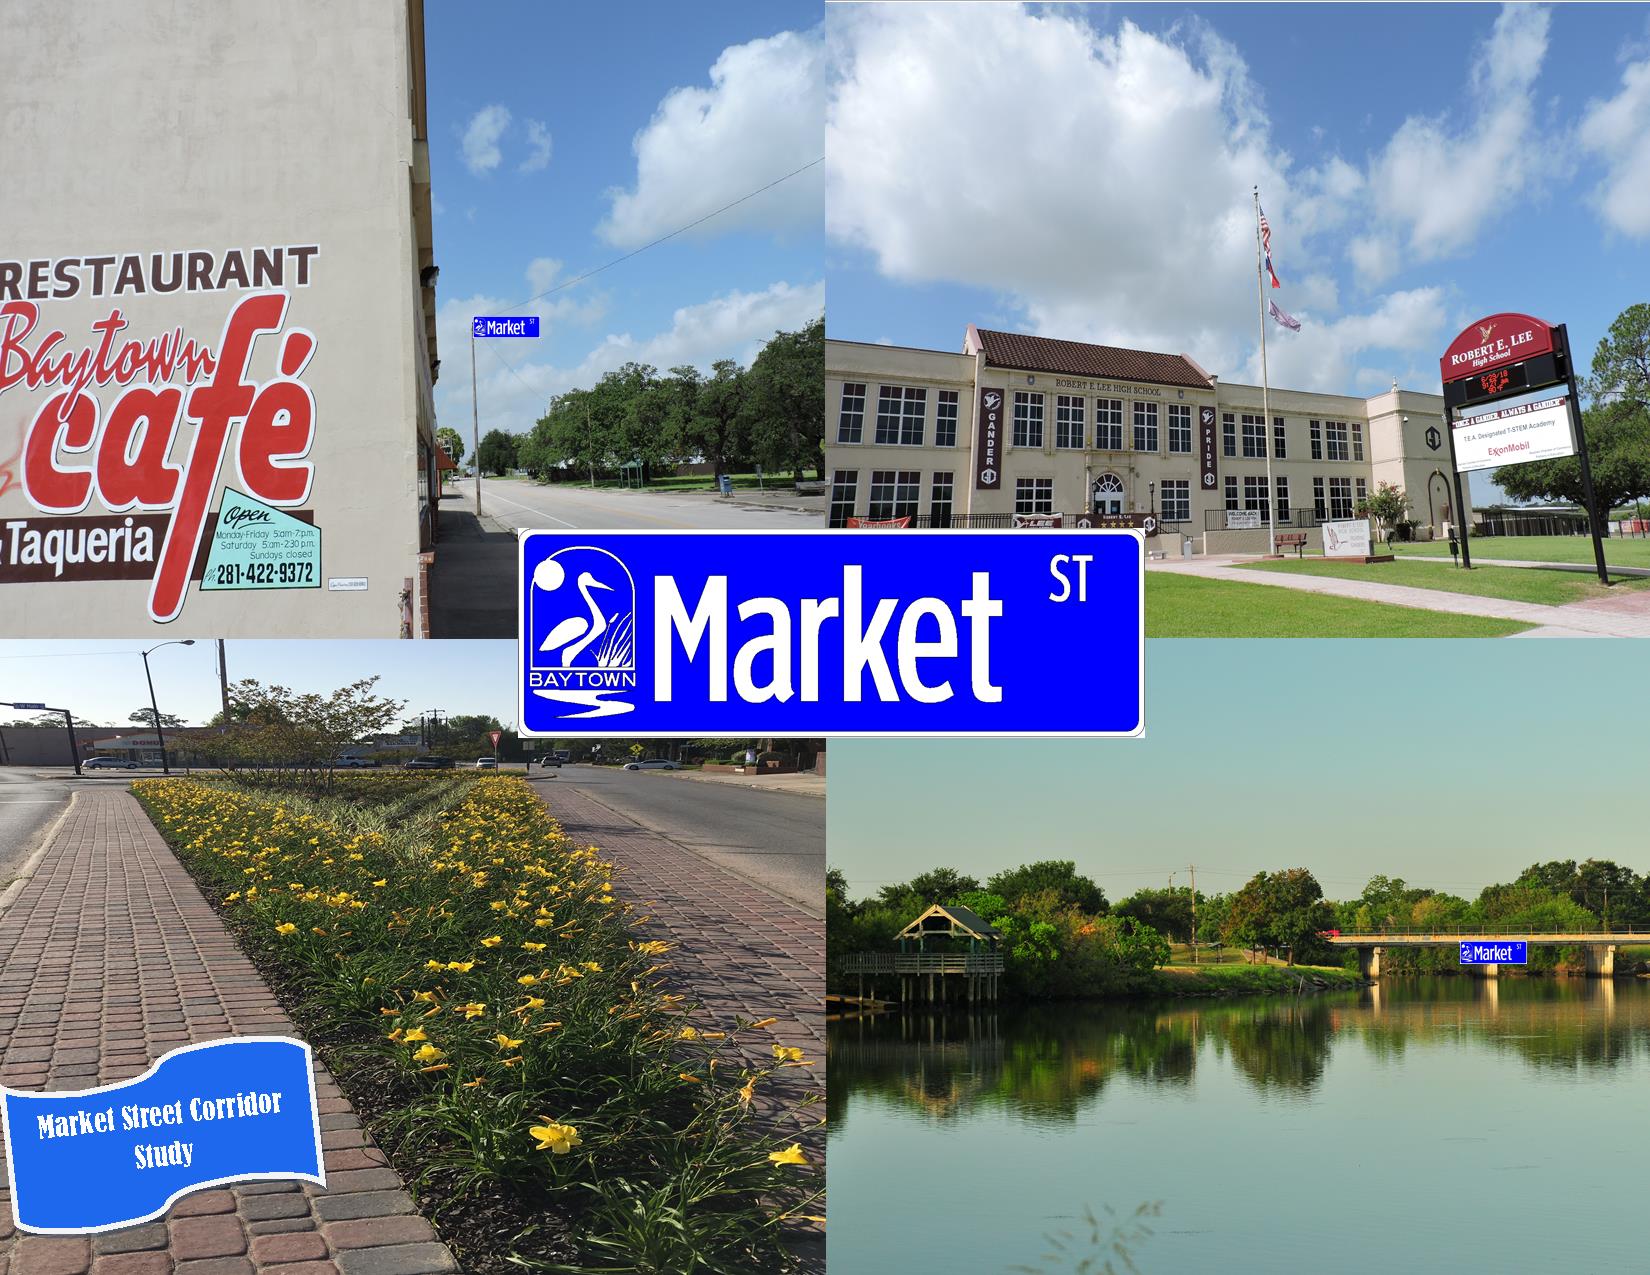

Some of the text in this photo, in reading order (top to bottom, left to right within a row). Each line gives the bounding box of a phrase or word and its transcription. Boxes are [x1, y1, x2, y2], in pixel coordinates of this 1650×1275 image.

[0, 246, 319, 300] RESTAURANT
[1451, 330, 1534, 365] ROBERT E. LEE
[0, 301, 216, 421] Baytown
[1472, 349, 1511, 368] High School
[1055, 379, 1088, 390] ROBERT
[1096, 383, 1112, 391] LEE
[1113, 385, 1132, 394] HIGH
[1133, 387, 1162, 396] SCHOOL
[1501, 406, 1526, 418] ALWAYS
[1527, 405, 1533, 413] A
[986, 413, 996, 465] GANDER
[1478, 428, 1506, 440] Designated
[1507, 424, 1528, 434] T-STEM
[1529, 419, 1556, 430] Academy
[1488, 441, 1531, 456] ExxonMobil
[223, 506, 271, 529] Open
[6, 517, 154, 577] Taqueria
[220, 541, 257, 550] Saturday
[250, 550, 313, 560] Sundays closed
